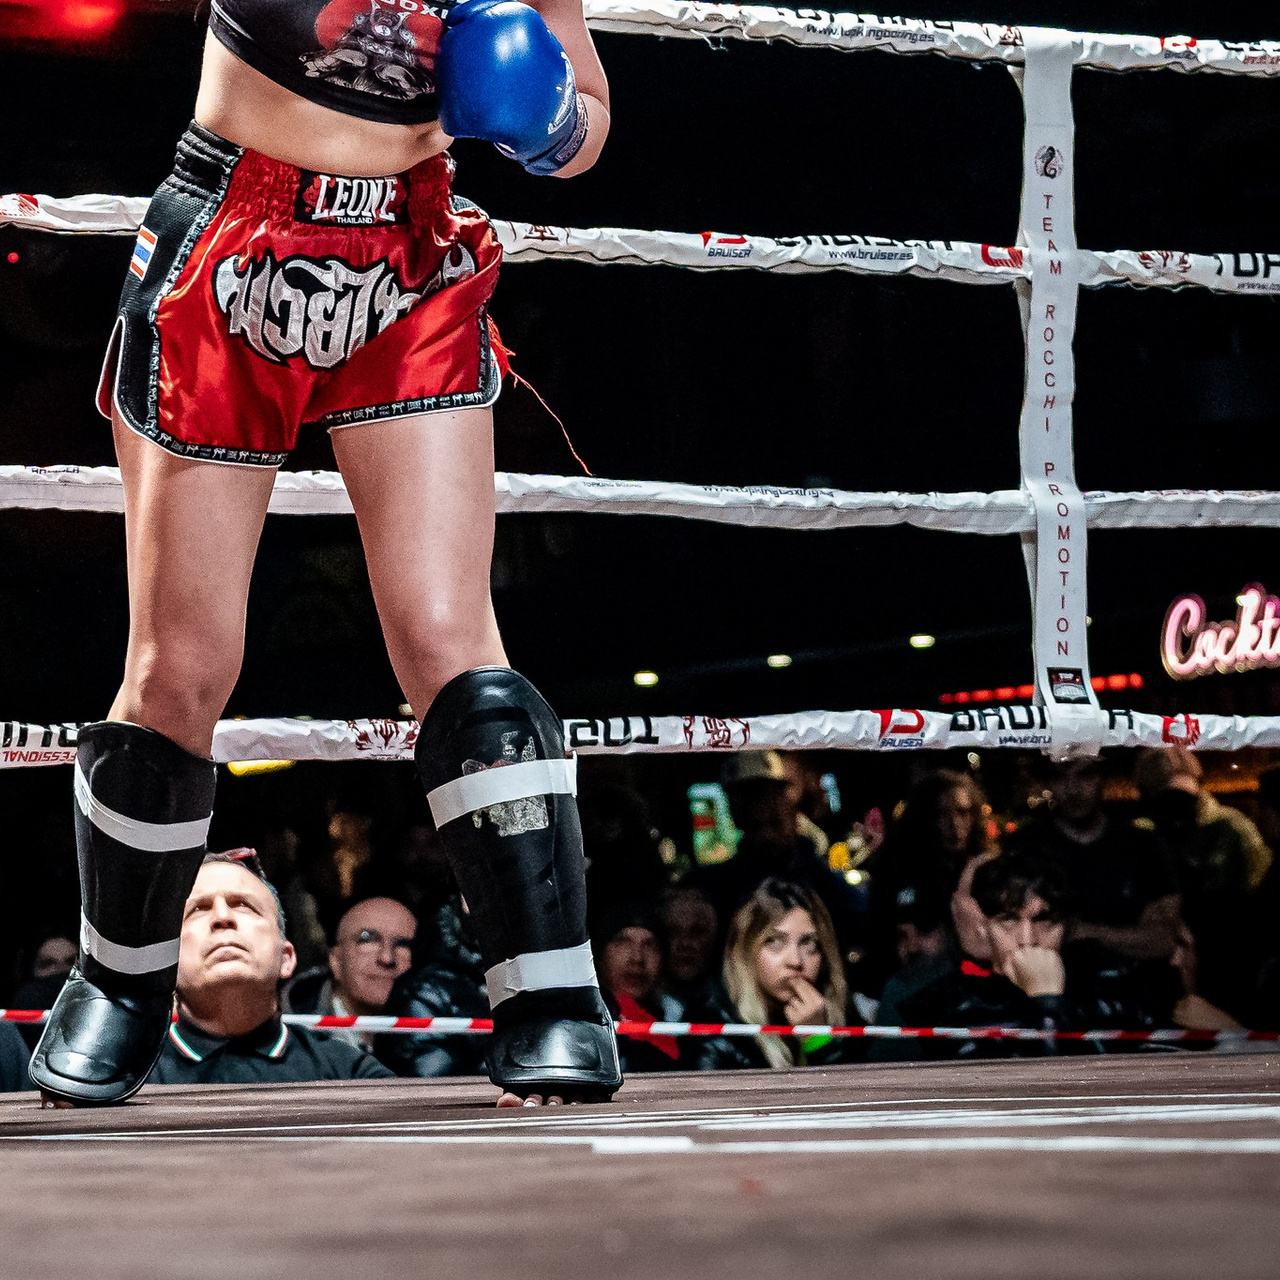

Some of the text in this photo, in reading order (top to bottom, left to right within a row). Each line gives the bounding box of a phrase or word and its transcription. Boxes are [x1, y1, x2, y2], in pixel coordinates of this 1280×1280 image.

[311, 174, 398, 221] LEONE
[337, 216, 373, 225] THAILAND
[707, 247, 752, 259] BRUISER
[828, 247, 914, 261] www.bruiser.es
[1042, 194, 1062, 275] TEAM
[1042, 304, 1057, 432] ROCCHI
[1044, 462, 1070, 656] PROMOTION
[1163, 586, 1280, 676] Cockt
